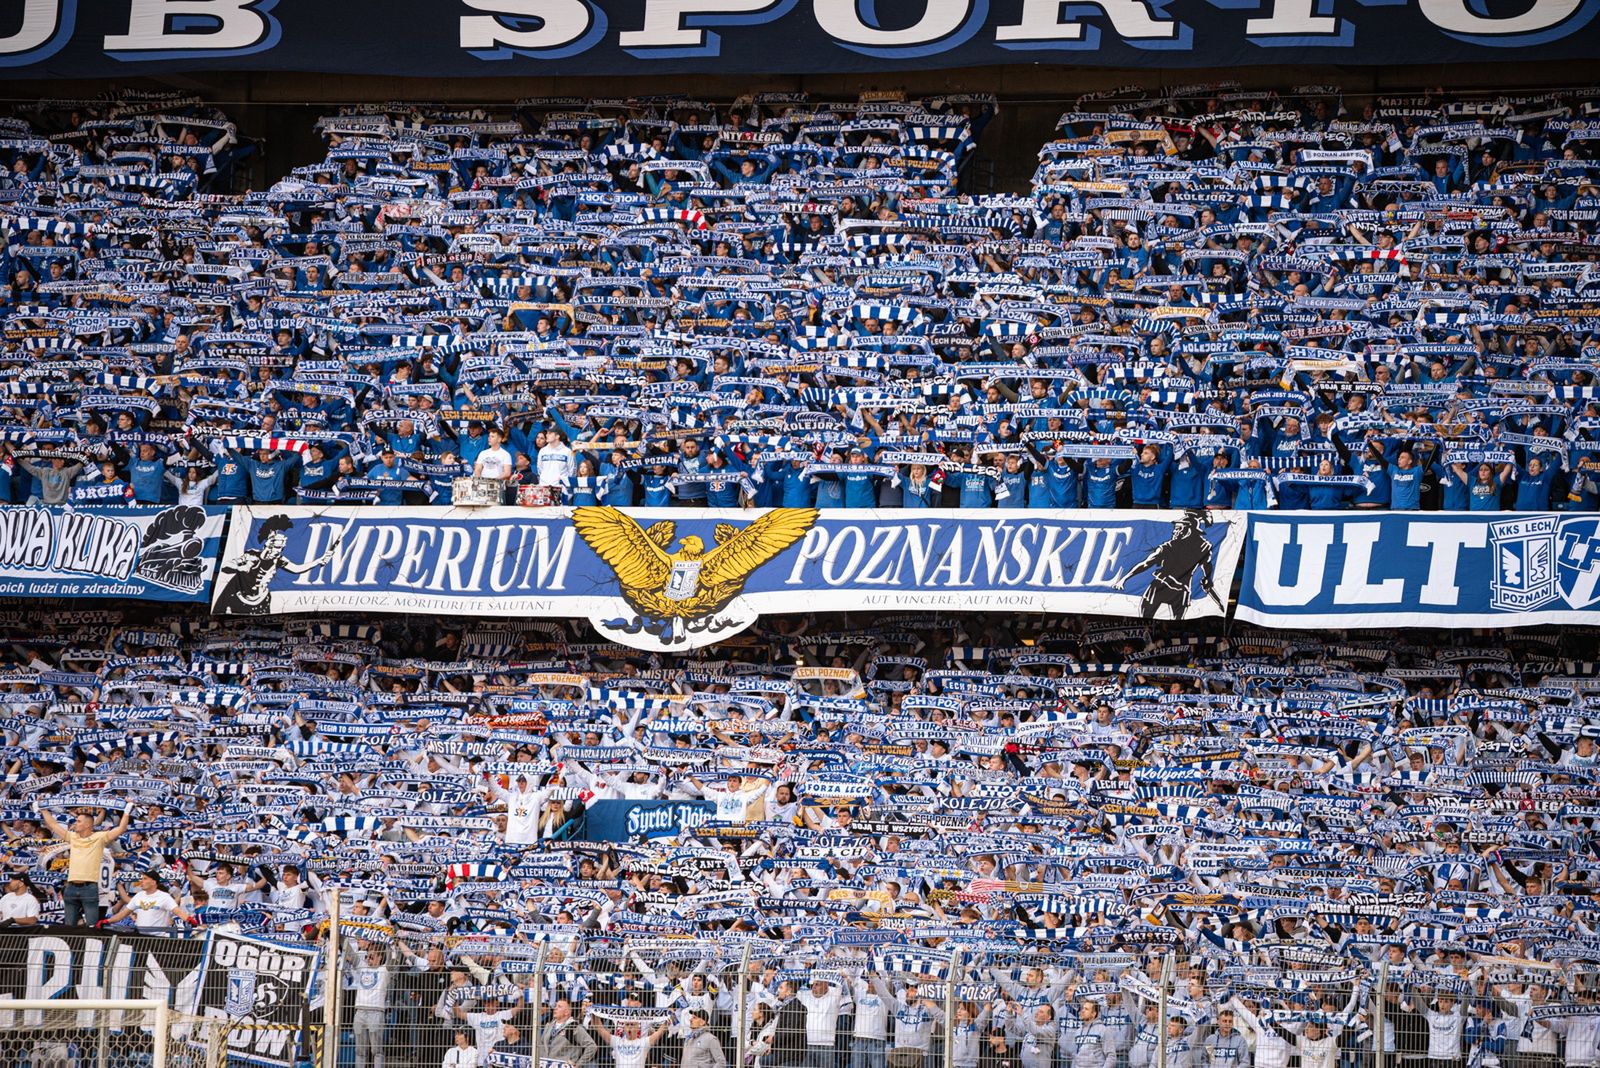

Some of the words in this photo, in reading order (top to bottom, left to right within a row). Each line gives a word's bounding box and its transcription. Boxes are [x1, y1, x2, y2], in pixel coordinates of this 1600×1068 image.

[1380, 109, 1440, 117] KOLEJORZ
[1447, 104, 1509, 115] LECH
[334, 124, 380, 132] KOLEJORZ
[850, 119, 891, 129] LECH
[844, 146, 863, 154] LECH
[887, 158, 904, 166] LECH
[1175, 194, 1235, 202] KOLEJORZ
[192, 265, 228, 273] KOLEJORZ
[1527, 264, 1585, 273] KOLEJORZ
[707, 292, 729, 300] LECH
[1260, 314, 1281, 323] LECH
[1222, 333, 1243, 341] LECH
[1182, 341, 1229, 353] KOLEJORZ
[439, 411, 461, 420] LECH
[114, 433, 141, 441] Lech
[145, 433, 169, 443] 1922
[882, 454, 904, 462] LECH
[622, 461, 642, 469] LECH
[1498, 526, 1519, 536] KKS
[1525, 521, 1550, 533] LECH
[53, 512, 139, 580] KLIKA
[292, 521, 575, 594] IMPERIUM
[785, 518, 1133, 588] POZNAŃSKIE
[1254, 522, 1488, 606] ULT
[29, 583, 57, 594] ludzi
[60, 584, 80, 594] nie
[82, 583, 145, 596] zdradzimy
[862, 595, 894, 605] AUT
[964, 595, 993, 605] AUT
[997, 595, 1034, 605] MORI
[1503, 586, 1549, 604] POZNAŃ
[295, 595, 317, 606] AVE
[394, 598, 463, 609] MORITURI
[466, 600, 481, 610] TE
[488, 601, 555, 612] SALUTANT
[109, 656, 135, 668] LECH
[513, 701, 537, 710] KOLE
[969, 700, 1034, 710] CHICKEN
[383, 710, 411, 719] LECH
[227, 747, 276, 757] KOLEJORZ
[223, 762, 241, 770] LECH
[1140, 768, 1195, 780] Kolejorz
[807, 782, 839, 793] FORZA
[845, 782, 870, 793] LECH
[939, 797, 1026, 811] KOLEJORZ
[626, 804, 673, 834] Fyrtel
[694, 829, 717, 837] LECH
[550, 841, 574, 850] LECH
[1199, 843, 1249, 853] KOLEJORZ
